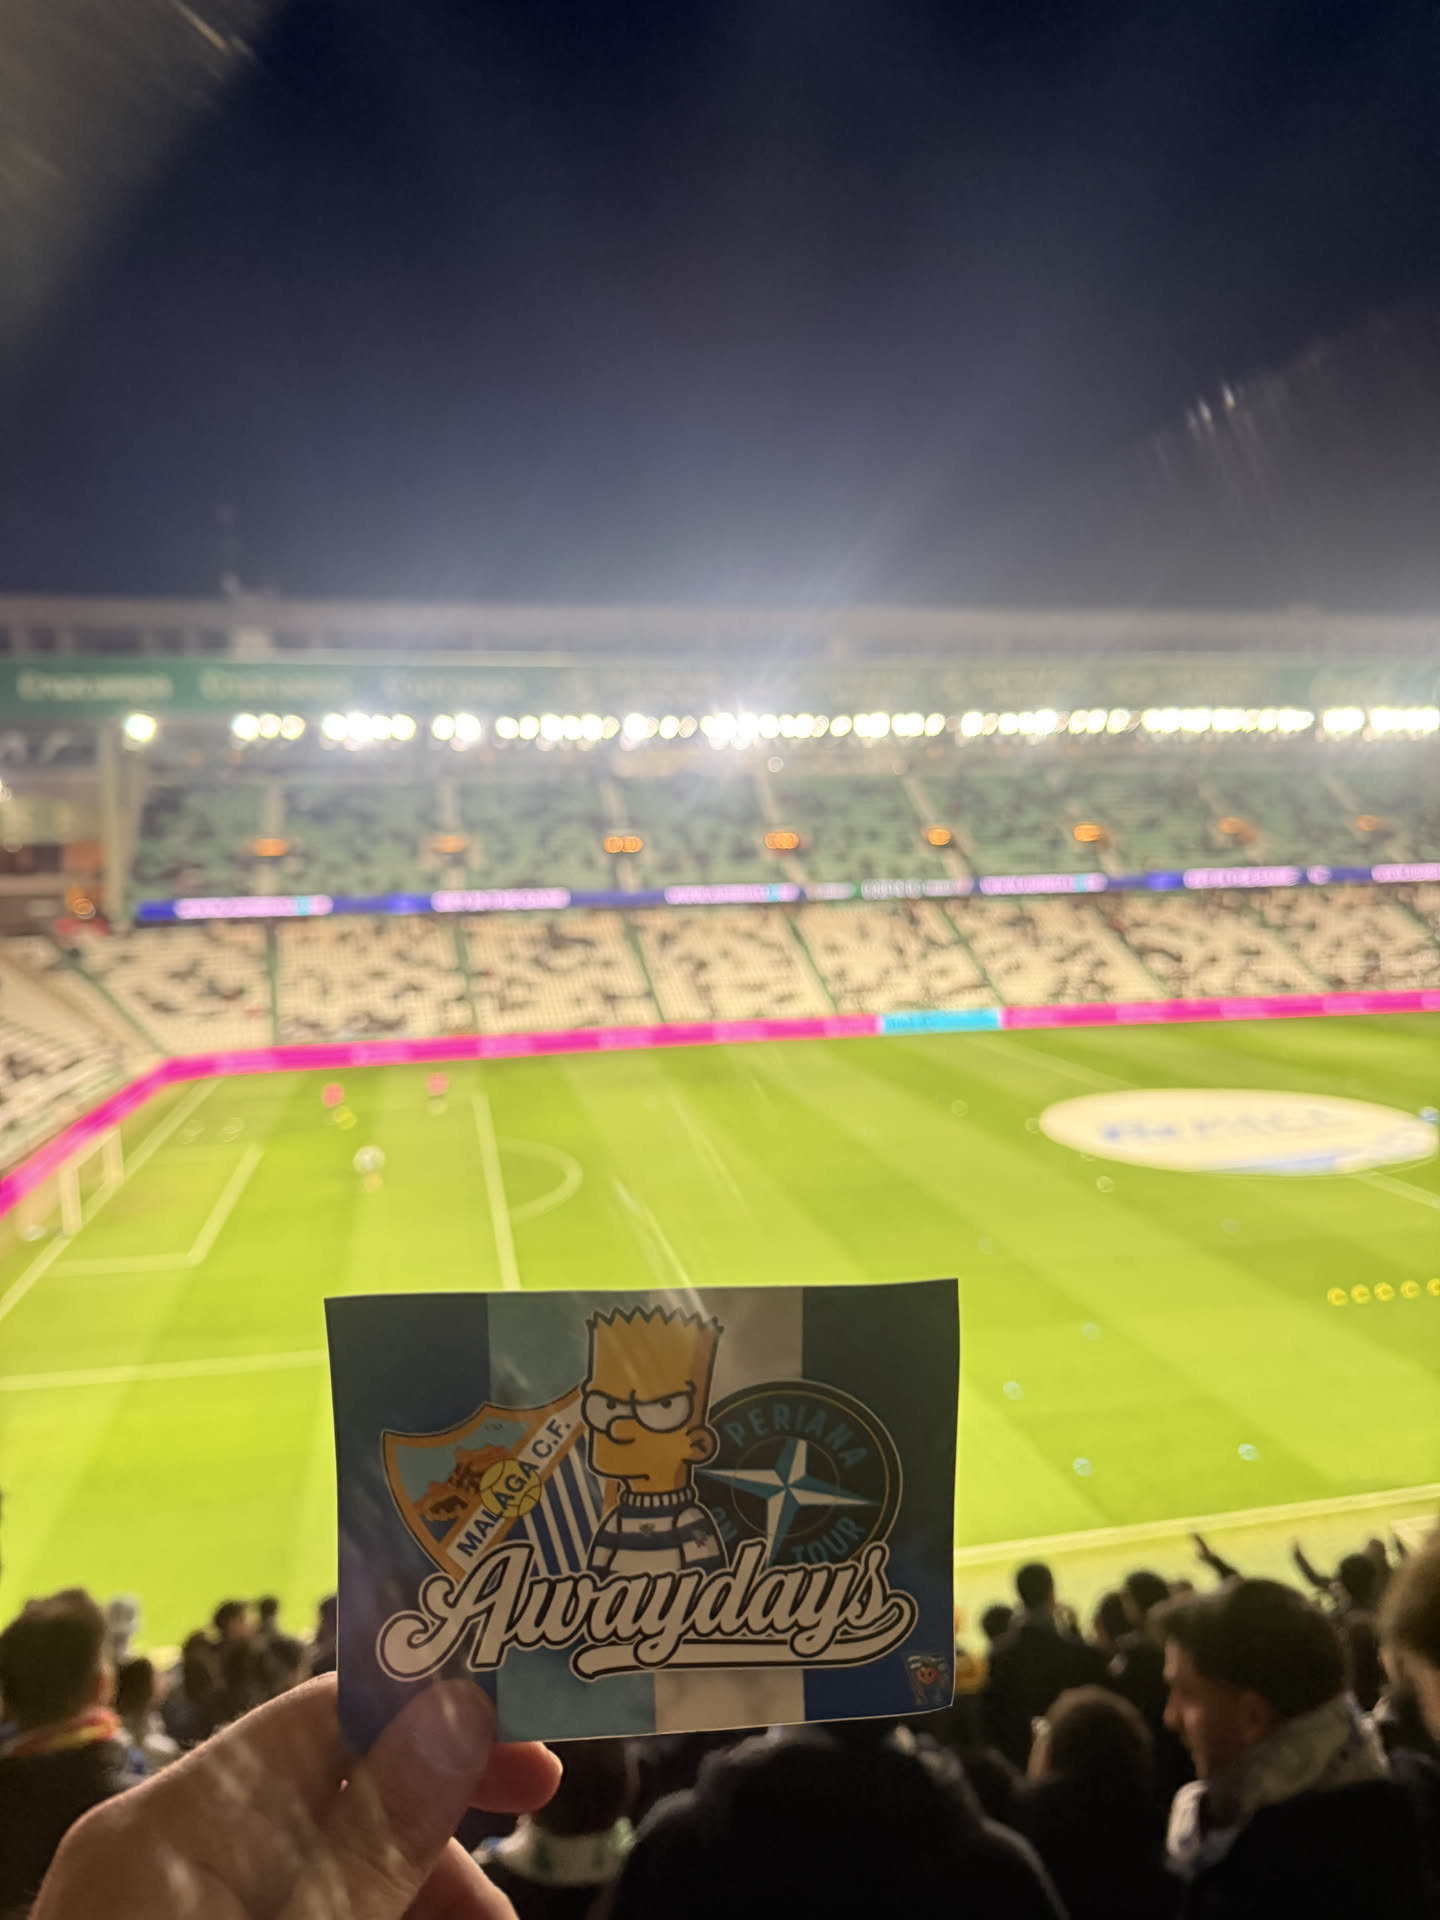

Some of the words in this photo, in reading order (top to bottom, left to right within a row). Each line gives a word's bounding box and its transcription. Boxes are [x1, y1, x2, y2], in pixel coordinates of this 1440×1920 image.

[724, 1402, 868, 1469] PERIANA
[457, 1460, 539, 1557] MALAGA
[531, 1418, 571, 1458] C.F.
[790, 1514, 866, 1563] TOUR
[376, 1538, 918, 1682] Awaydays
